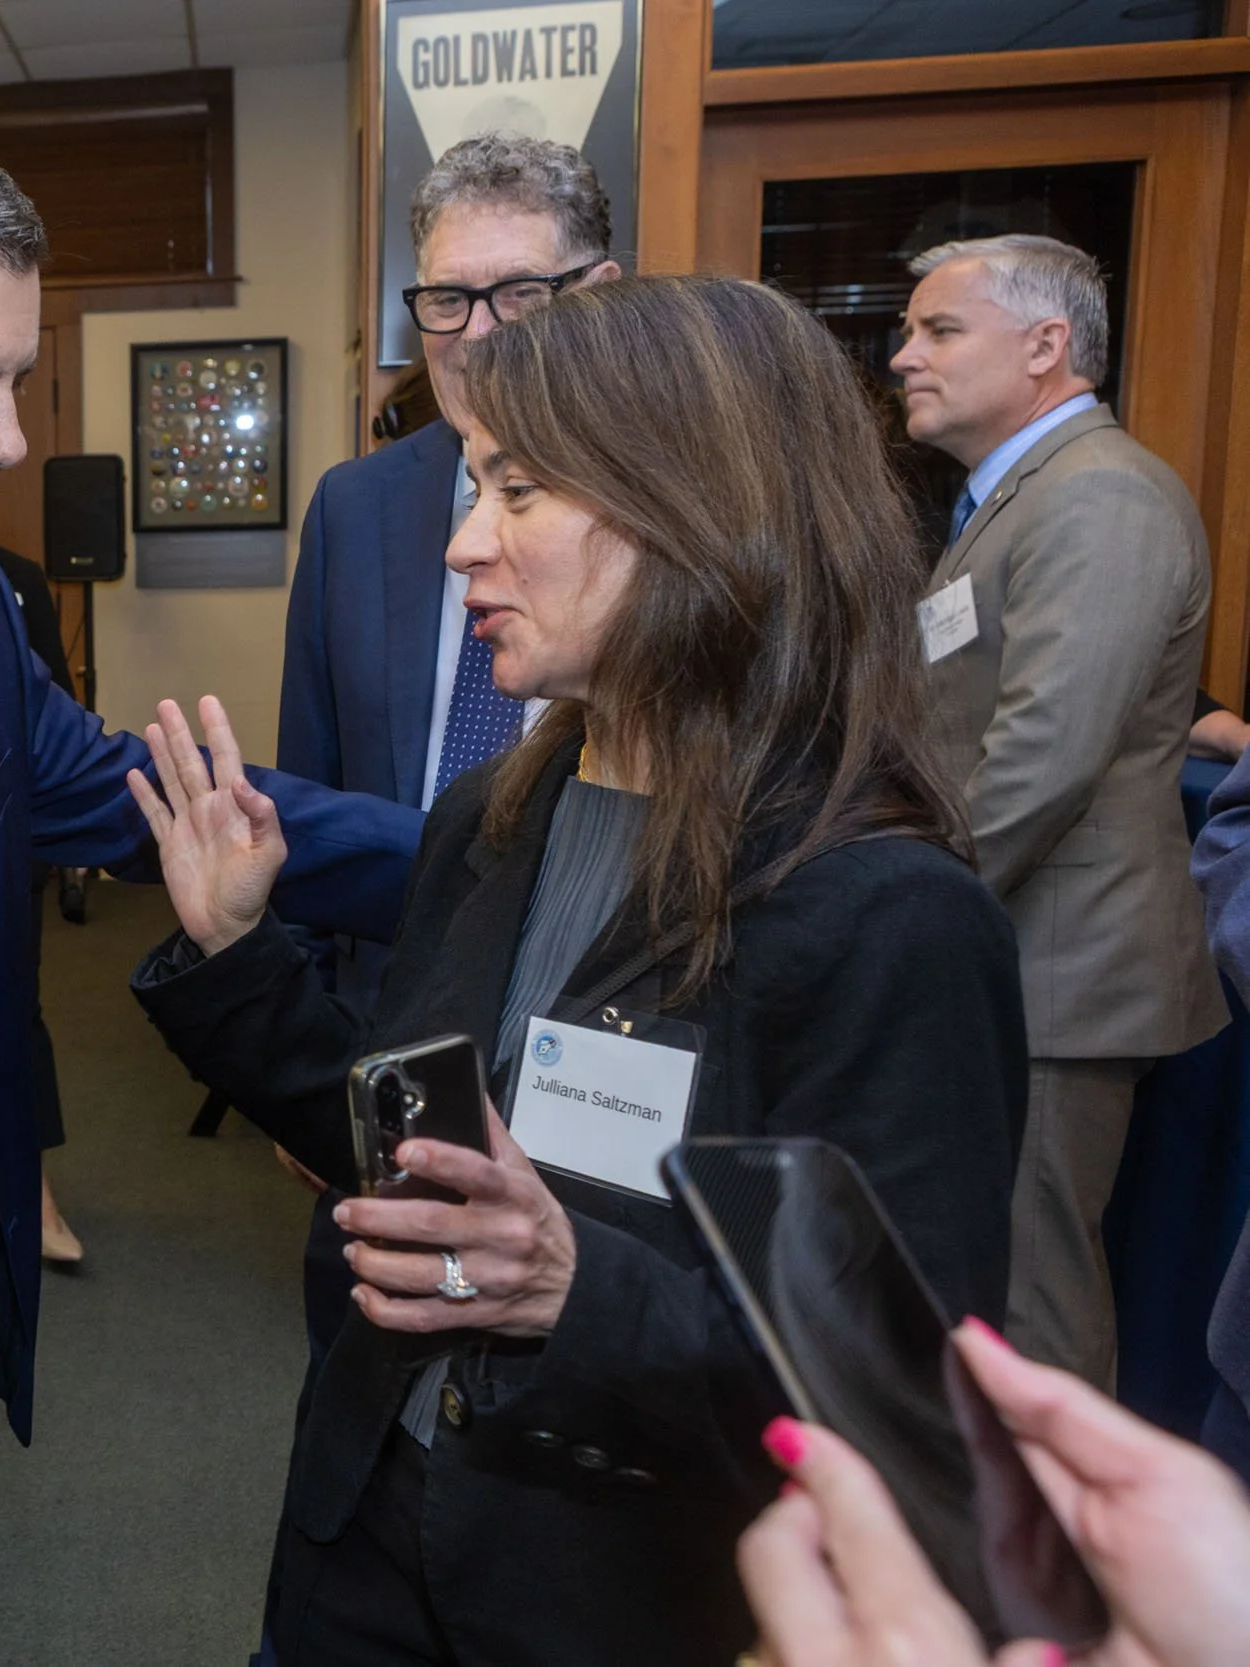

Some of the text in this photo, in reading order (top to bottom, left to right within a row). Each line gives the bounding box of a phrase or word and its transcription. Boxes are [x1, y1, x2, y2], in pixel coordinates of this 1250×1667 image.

[411, 22, 599, 90] GOLDWATER
[532, 1075, 662, 1123] Julliana Saltzman
